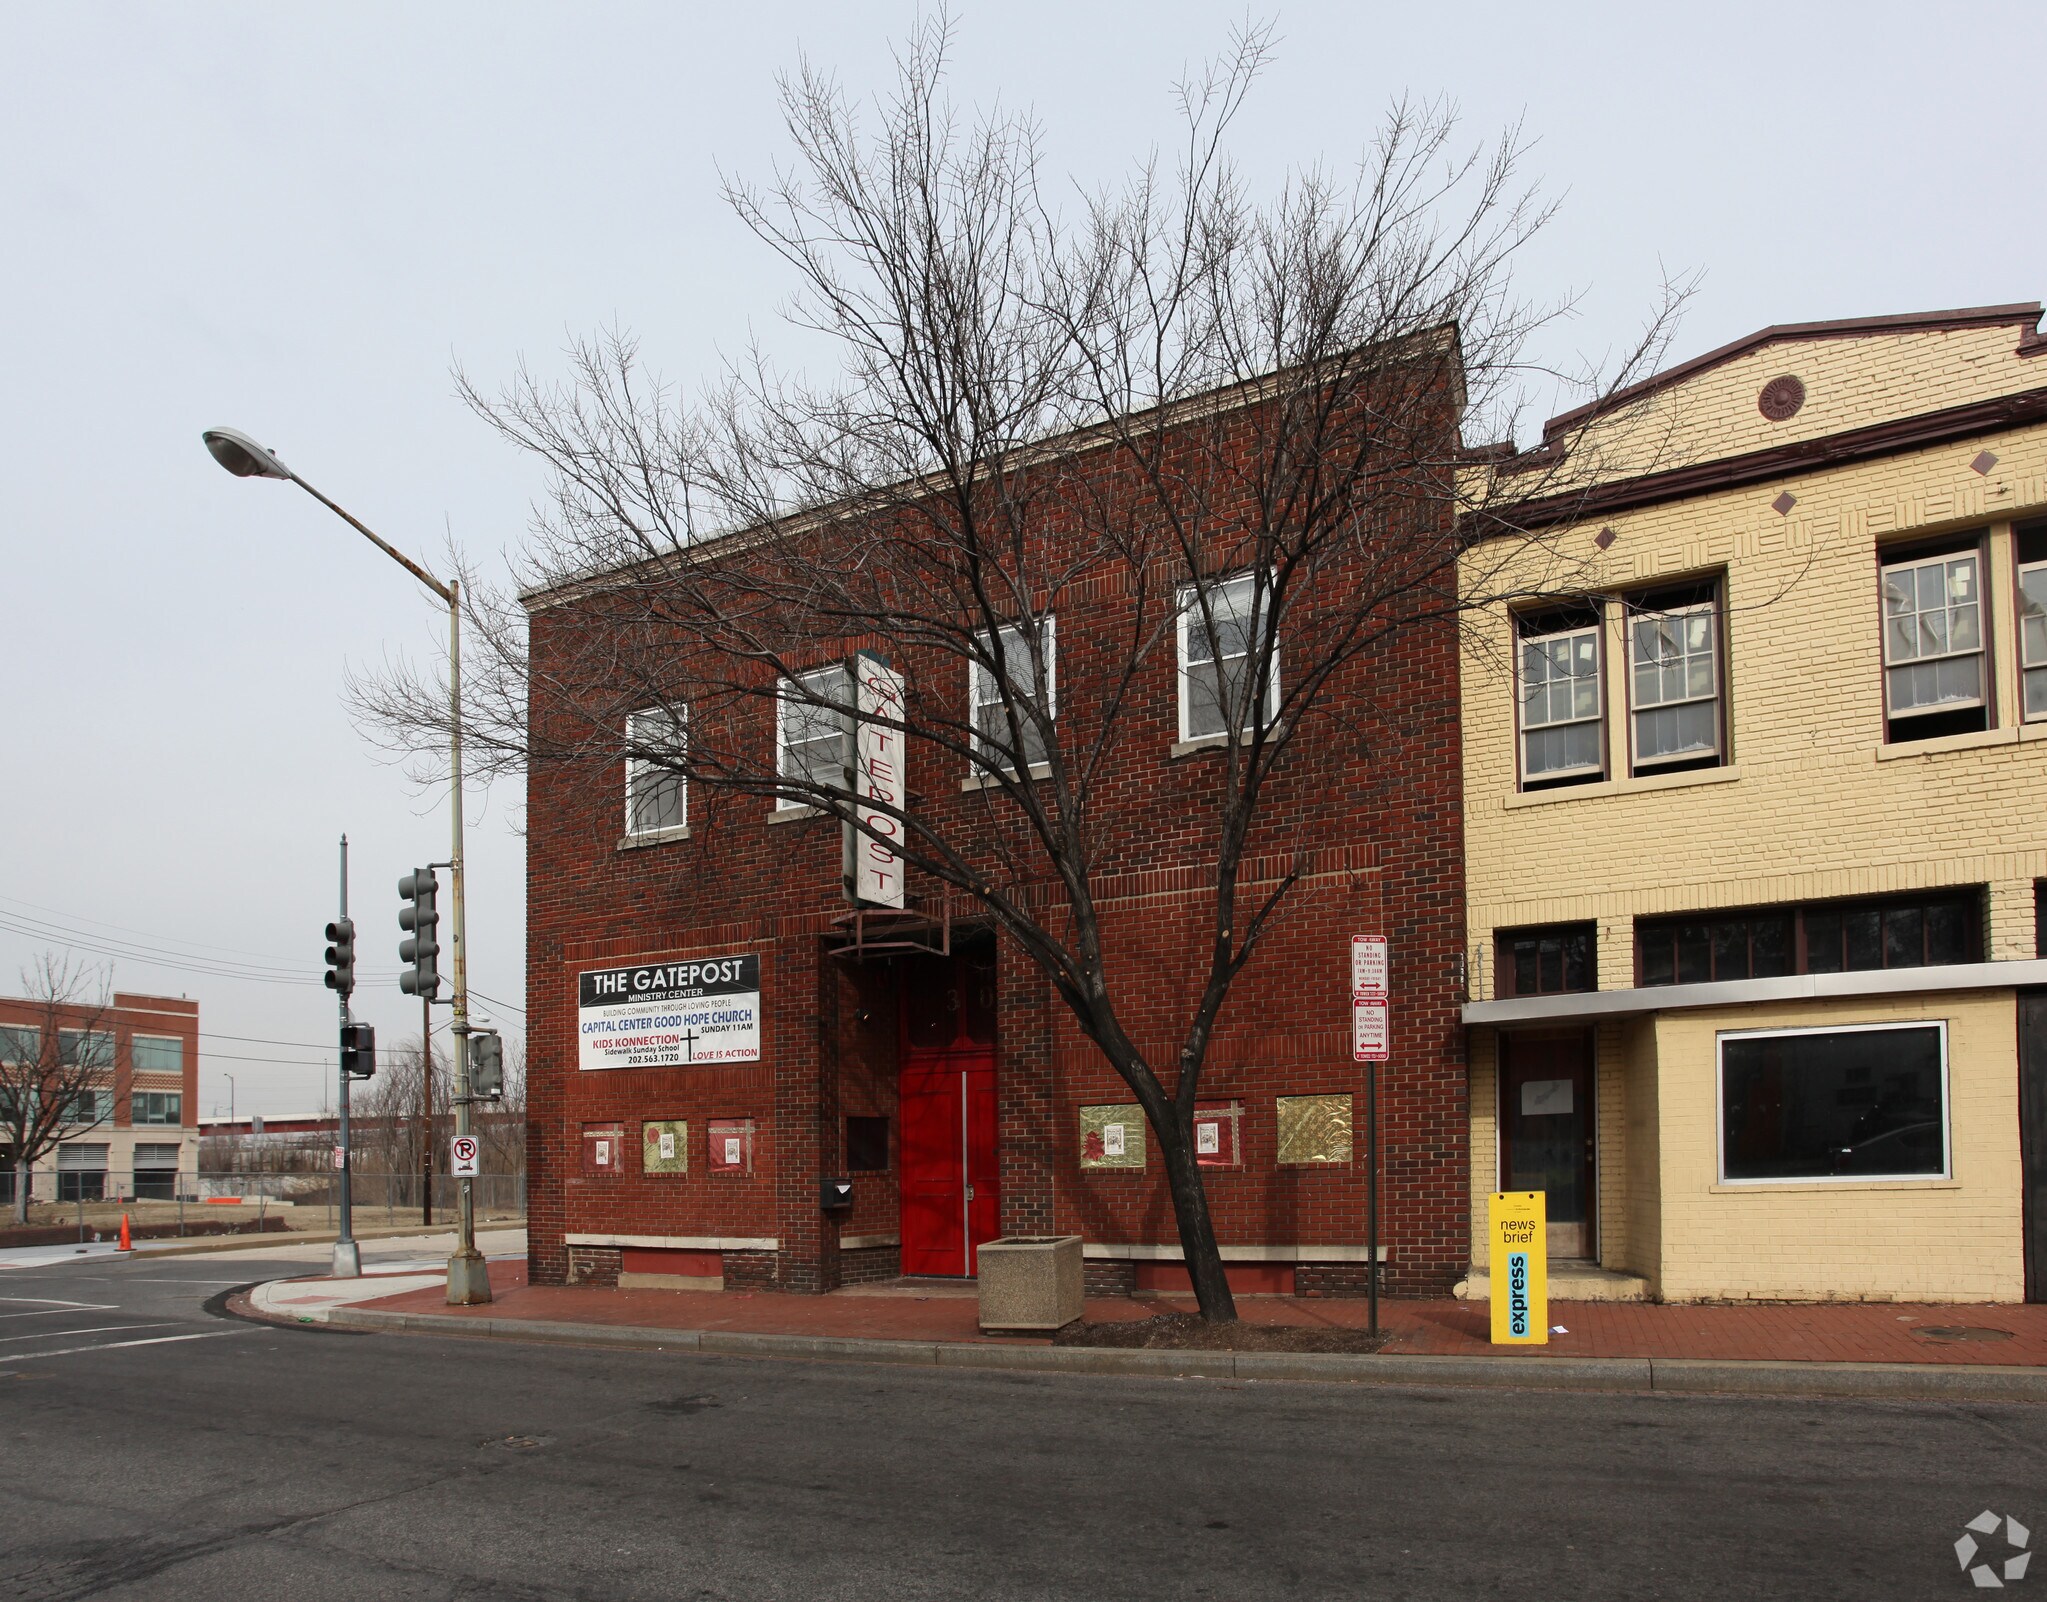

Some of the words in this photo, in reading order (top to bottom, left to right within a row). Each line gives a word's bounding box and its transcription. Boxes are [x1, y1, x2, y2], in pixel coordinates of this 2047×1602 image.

[593, 972, 627, 994] THE
[633, 960, 743, 991] GATEPOST
[628, 991, 667, 1003] MINISTRY
[668, 988, 703, 999] CENTER
[603, 1008, 627, 1018] BUILDING
[627, 1005, 661, 1016] COMMUNITY
[661, 1002, 687, 1013] THROUGH
[688, 1000, 710, 1010] LOVING
[711, 999, 731, 1008] PEOPLE
[582, 1020, 617, 1034] CAPITAL
[618, 1017, 652, 1031] CENTER
[654, 1015, 682, 1028] GOOD
[684, 1012, 710, 1026] HOPE
[711, 1009, 752, 1024] CHURCH
[700, 1023, 731, 1034] SUNDAY
[733, 1022, 754, 1032] 11AM
[593, 1039, 613, 1049] KIDS
[615, 1034, 679, 1048] KONNECTION
[604, 1046, 632, 1056] Sidewalk
[633, 1045, 656, 1055] Sunday
[658, 1044, 680, 1052] School
[692, 1051, 714, 1060] LOVE
[716, 1050, 723, 1058] IS
[724, 1048, 758, 1058] ACTION
[628, 1053, 679, 1064] 202.563.1720
[1500, 1220, 1536, 1230] news
[1503, 1231, 1533, 1243] brief
[1511, 1256, 1528, 1335] express
